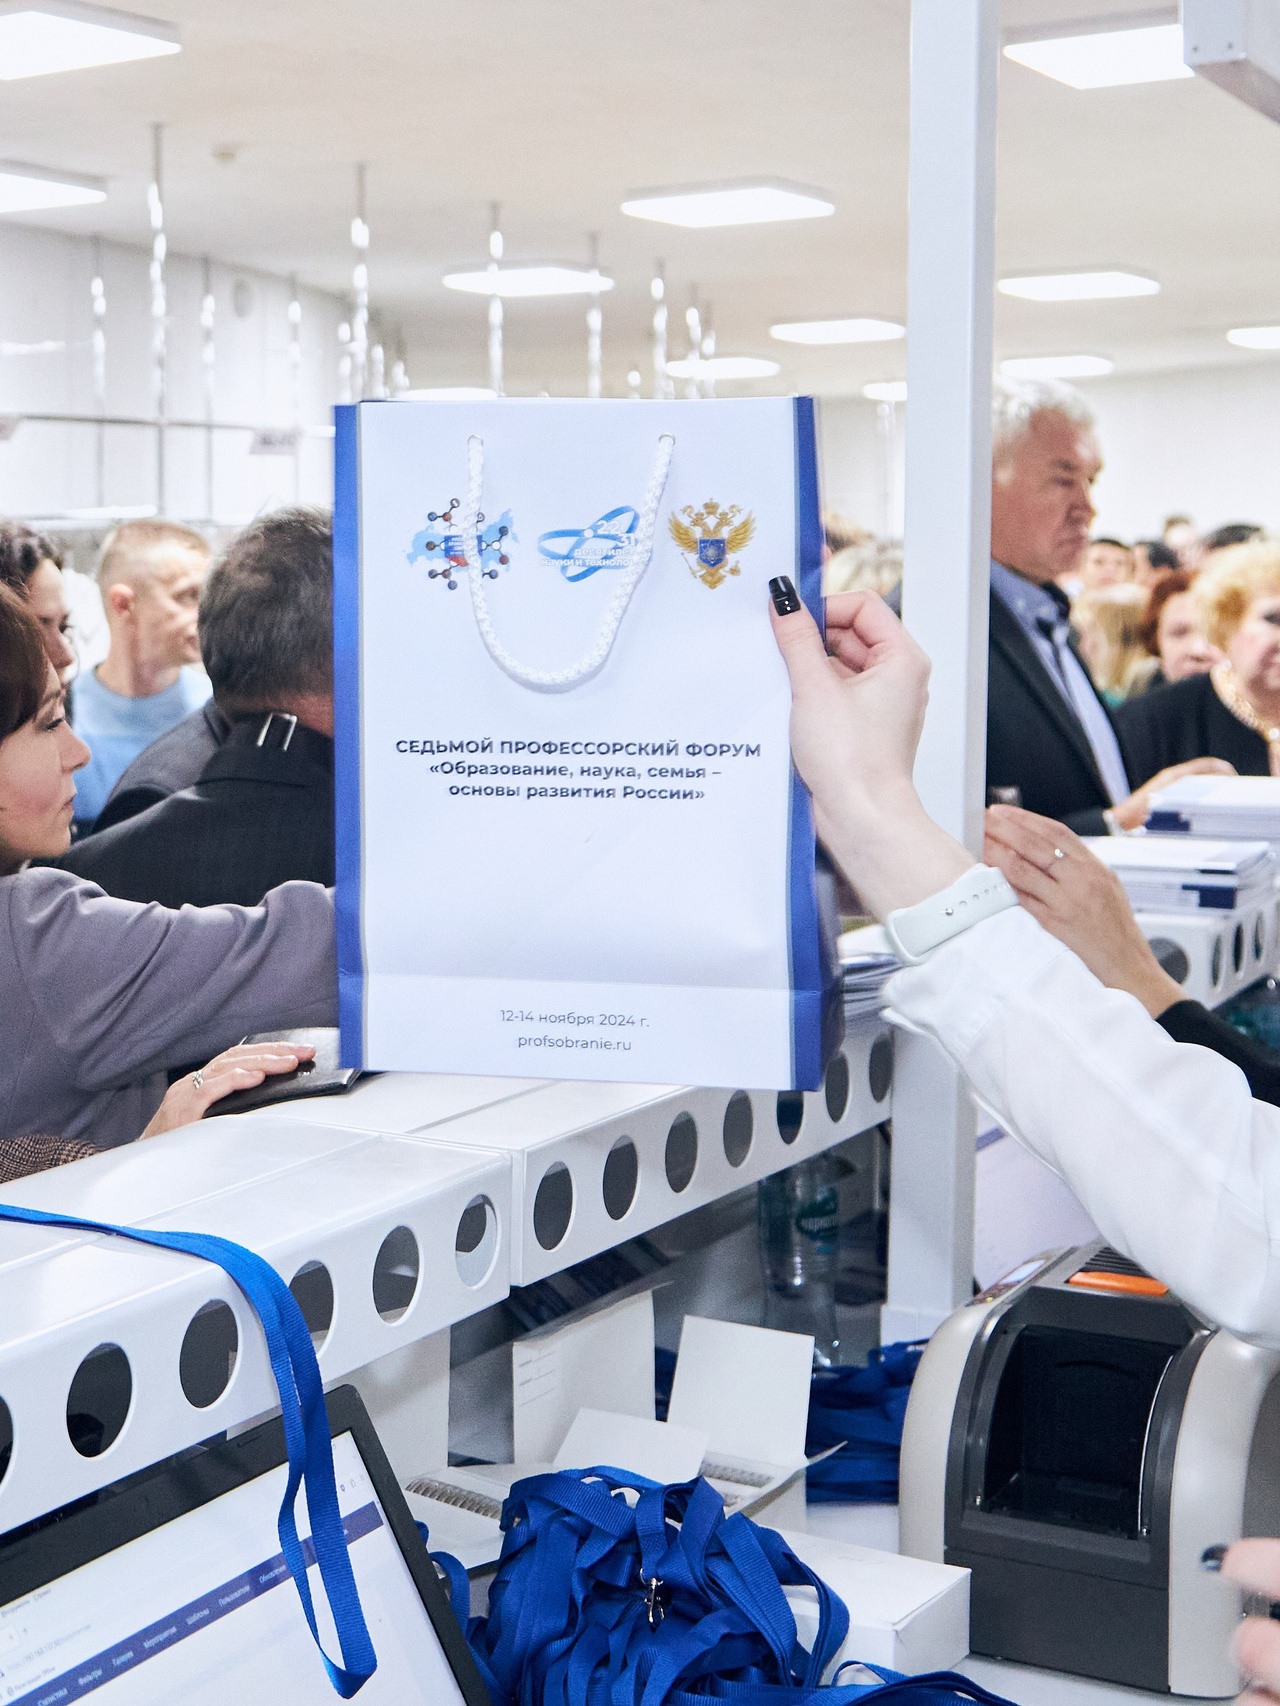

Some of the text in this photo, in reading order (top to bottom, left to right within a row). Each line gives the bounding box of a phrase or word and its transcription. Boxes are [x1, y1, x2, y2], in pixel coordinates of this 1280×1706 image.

[597, 520, 622, 535] 22
[616, 533, 635, 547] 31
[541, 559, 574, 568] науки
[586, 559, 631, 567] техноло
[395, 736, 761, 758] СЕДЬМОЙ ПРОФЕССОРСКИЙ ФОРУМ
[429, 760, 574, 779] «Образование,
[579, 765, 642, 781] наука,
[647, 767, 707, 779] семья
[448, 784, 706, 801] основы развития России»
[500, 1009, 650, 1028] 12-14 ноября 2024 г.
[518, 1034, 632, 1051] profsobranie.ru
